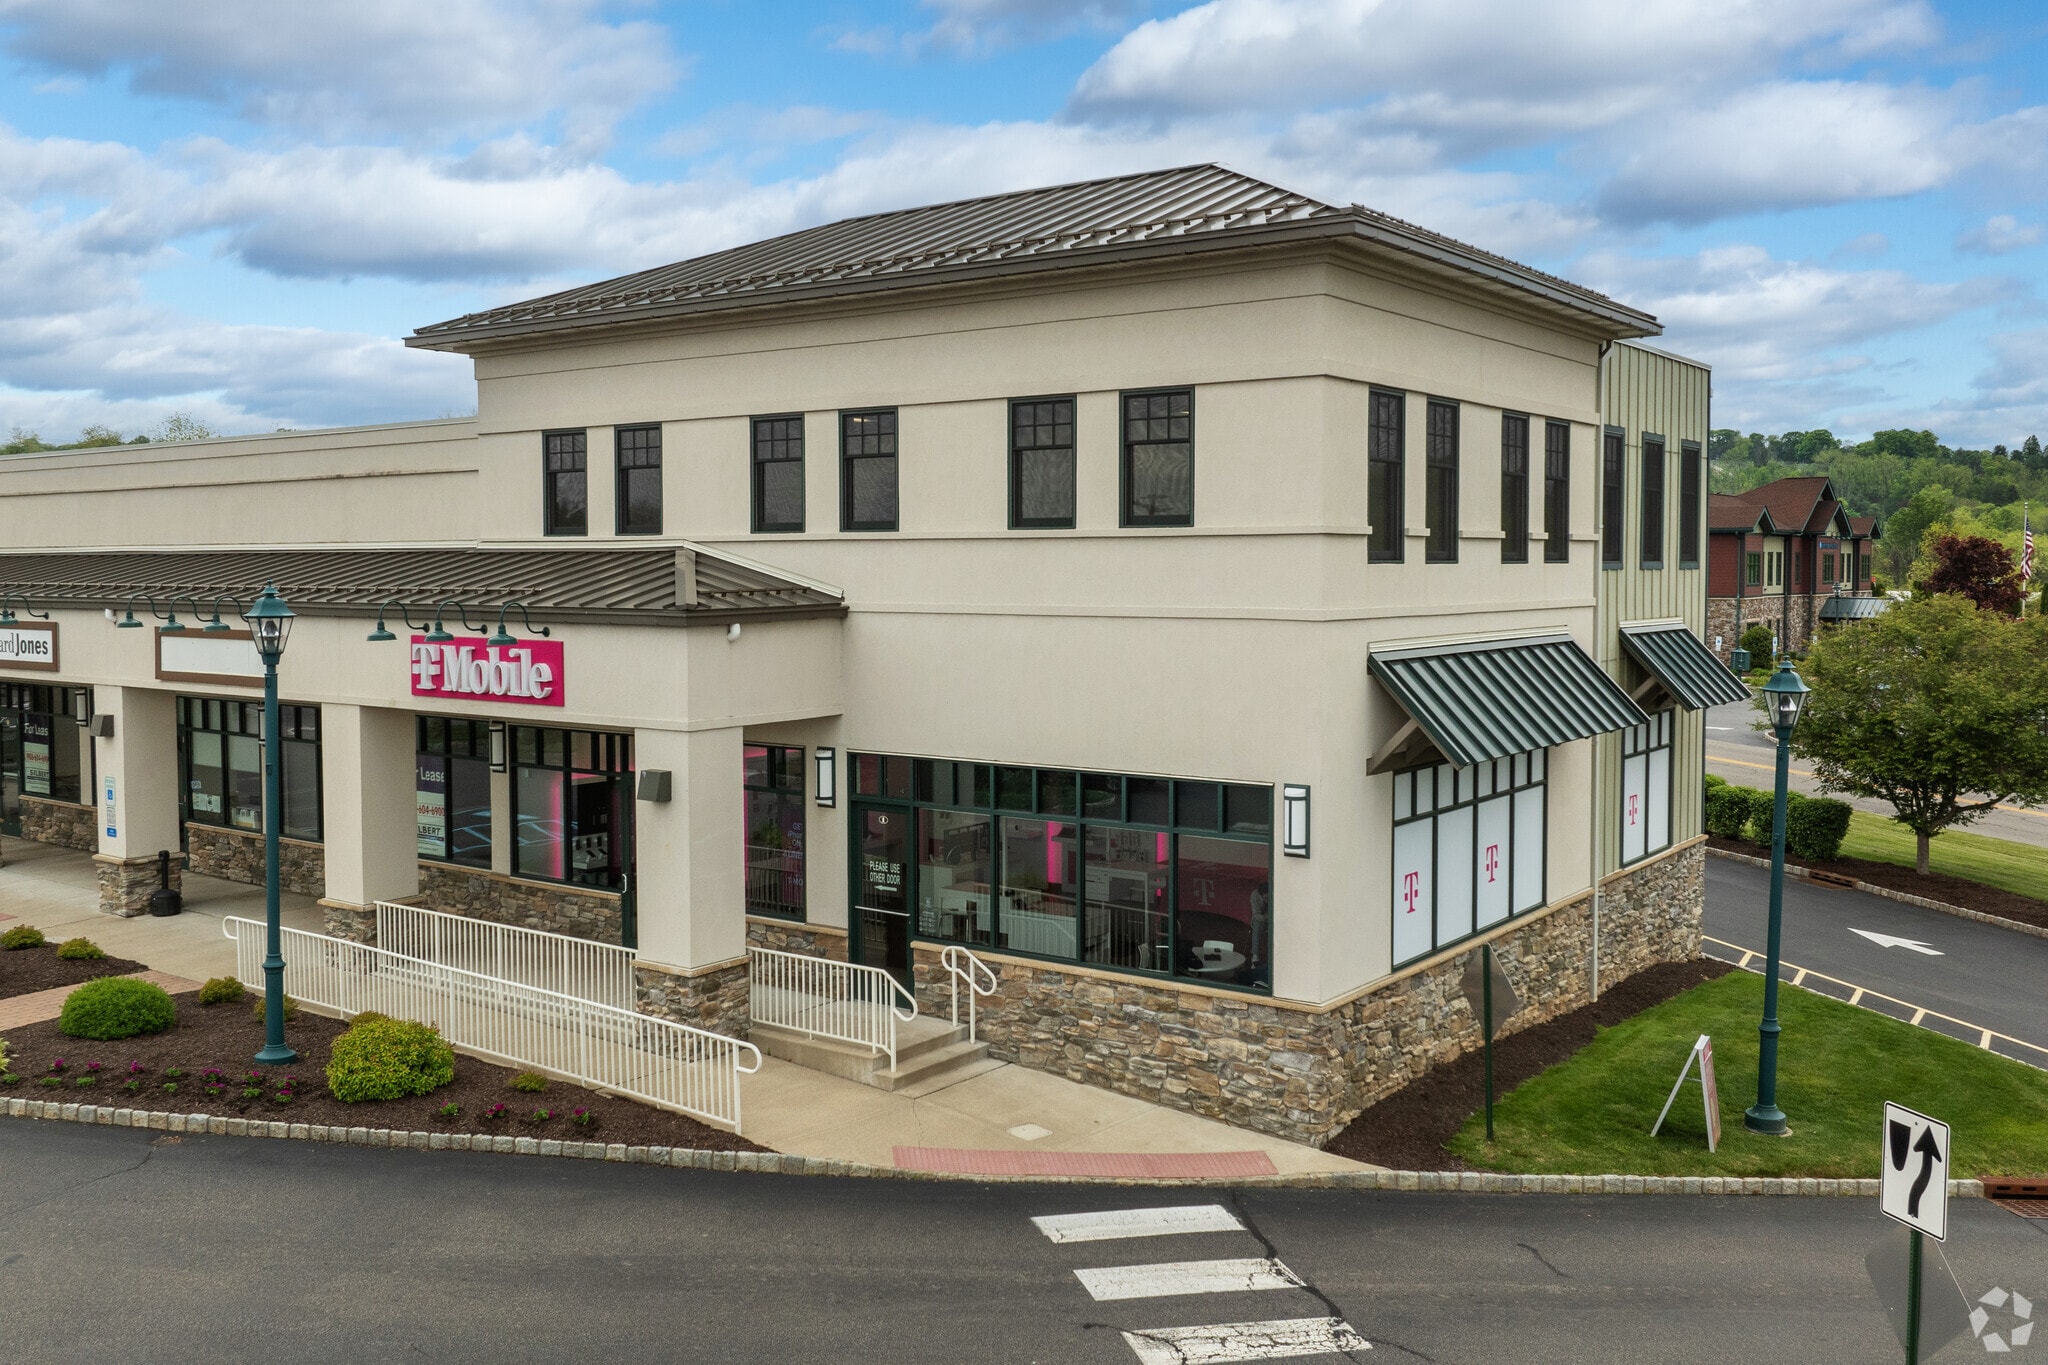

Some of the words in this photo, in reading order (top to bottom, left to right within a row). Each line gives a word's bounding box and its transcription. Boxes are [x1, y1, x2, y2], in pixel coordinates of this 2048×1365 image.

[15, 632, 49, 657] Jones
[441, 644, 553, 699] Mobile
[24, 723, 34, 734] For
[1628, 794, 1638, 825] T
[869, 860, 889, 872] PLEASE
[889, 862, 901, 874] USE
[1486, 844, 1499, 883] T
[869, 872, 886, 884] OTHER
[886, 873, 901, 886] DOOR
[1404, 871, 1419, 914] T
